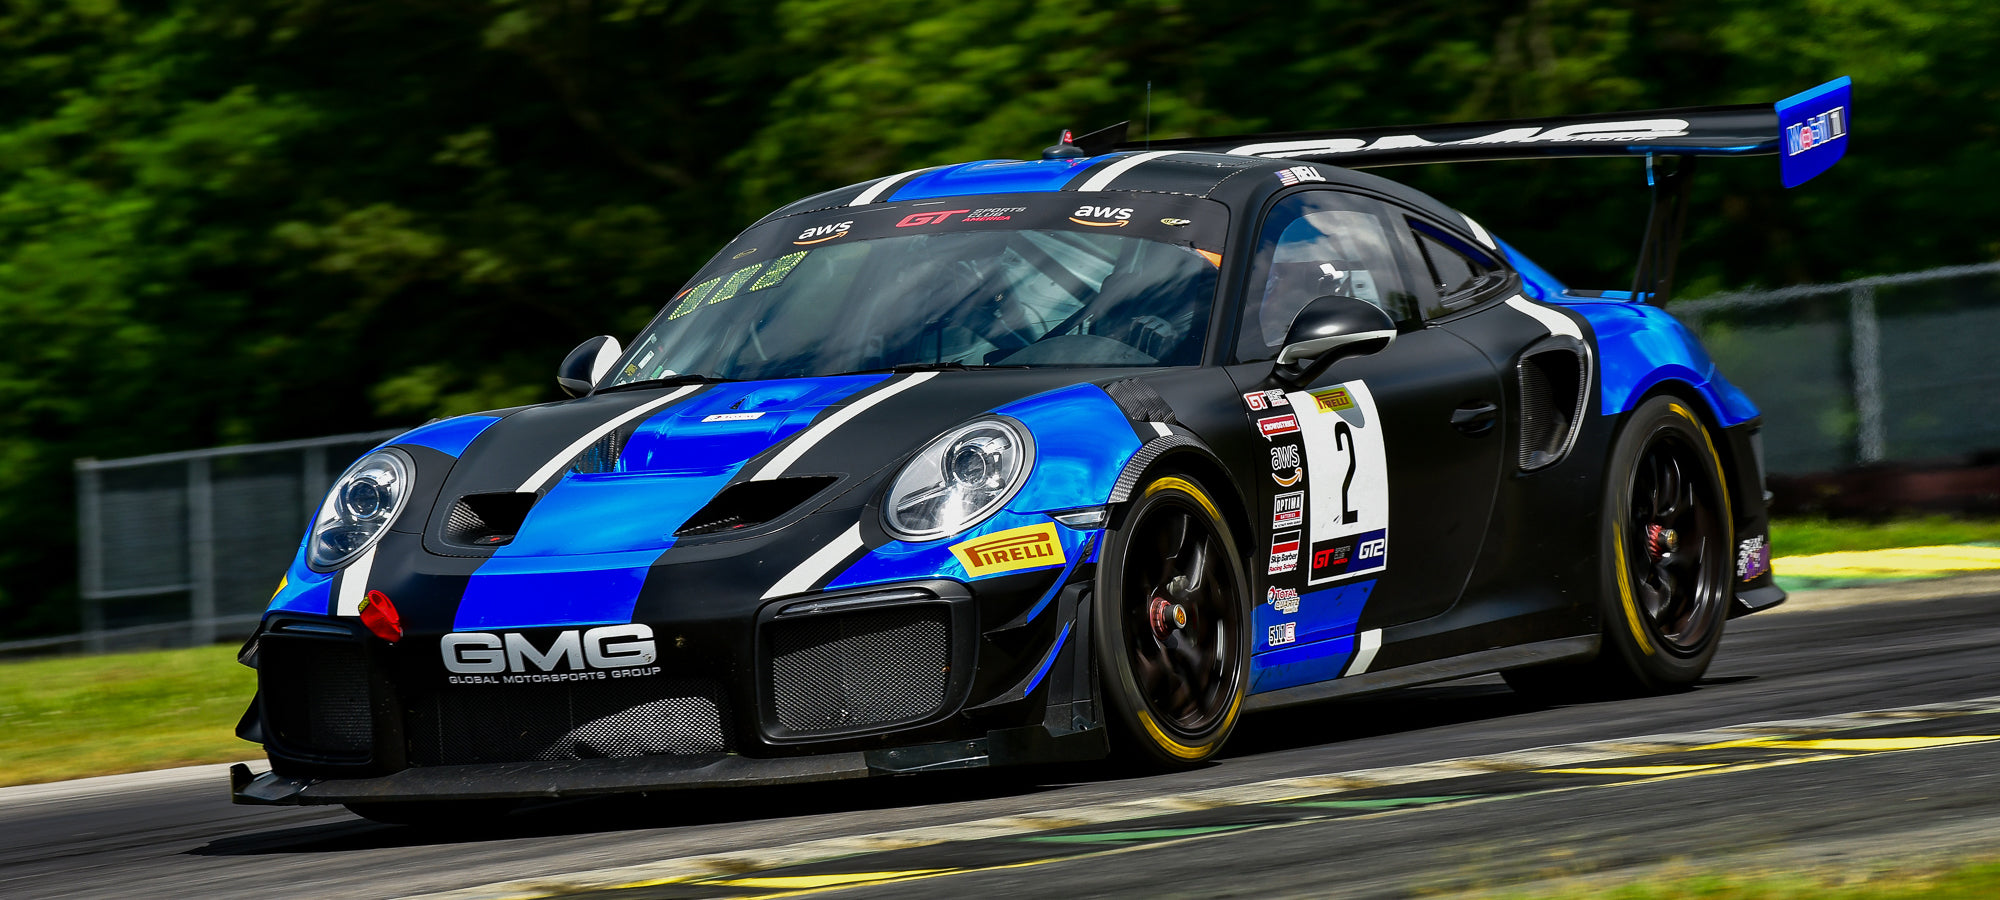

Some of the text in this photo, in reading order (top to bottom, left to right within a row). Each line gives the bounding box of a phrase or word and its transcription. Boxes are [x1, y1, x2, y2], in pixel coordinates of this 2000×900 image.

[1786, 114, 1830, 155] Mobil
[896, 206, 1027, 228] GT SPORTS
[1074, 205, 1134, 220] aws
[798, 220, 854, 240] aws
[1244, 391, 1268, 410] GT
[1315, 391, 1350, 410] PIRELLI
[1271, 444, 1300, 470] aws
[1334, 421, 1359, 525] 2
[1276, 496, 1300, 512] OPTIMA
[963, 532, 1054, 568] PIRELLI
[1270, 552, 1298, 564] Skip Barber
[1313, 548, 1335, 569] GT
[1358, 538, 1385, 560] GT2
[1275, 588, 1297, 599] TOTAL
[1269, 624, 1286, 646] 5.11
[440, 623, 657, 674] GMG
[449, 666, 662, 685] GLOBAL MOTORSPORTS GROUP
